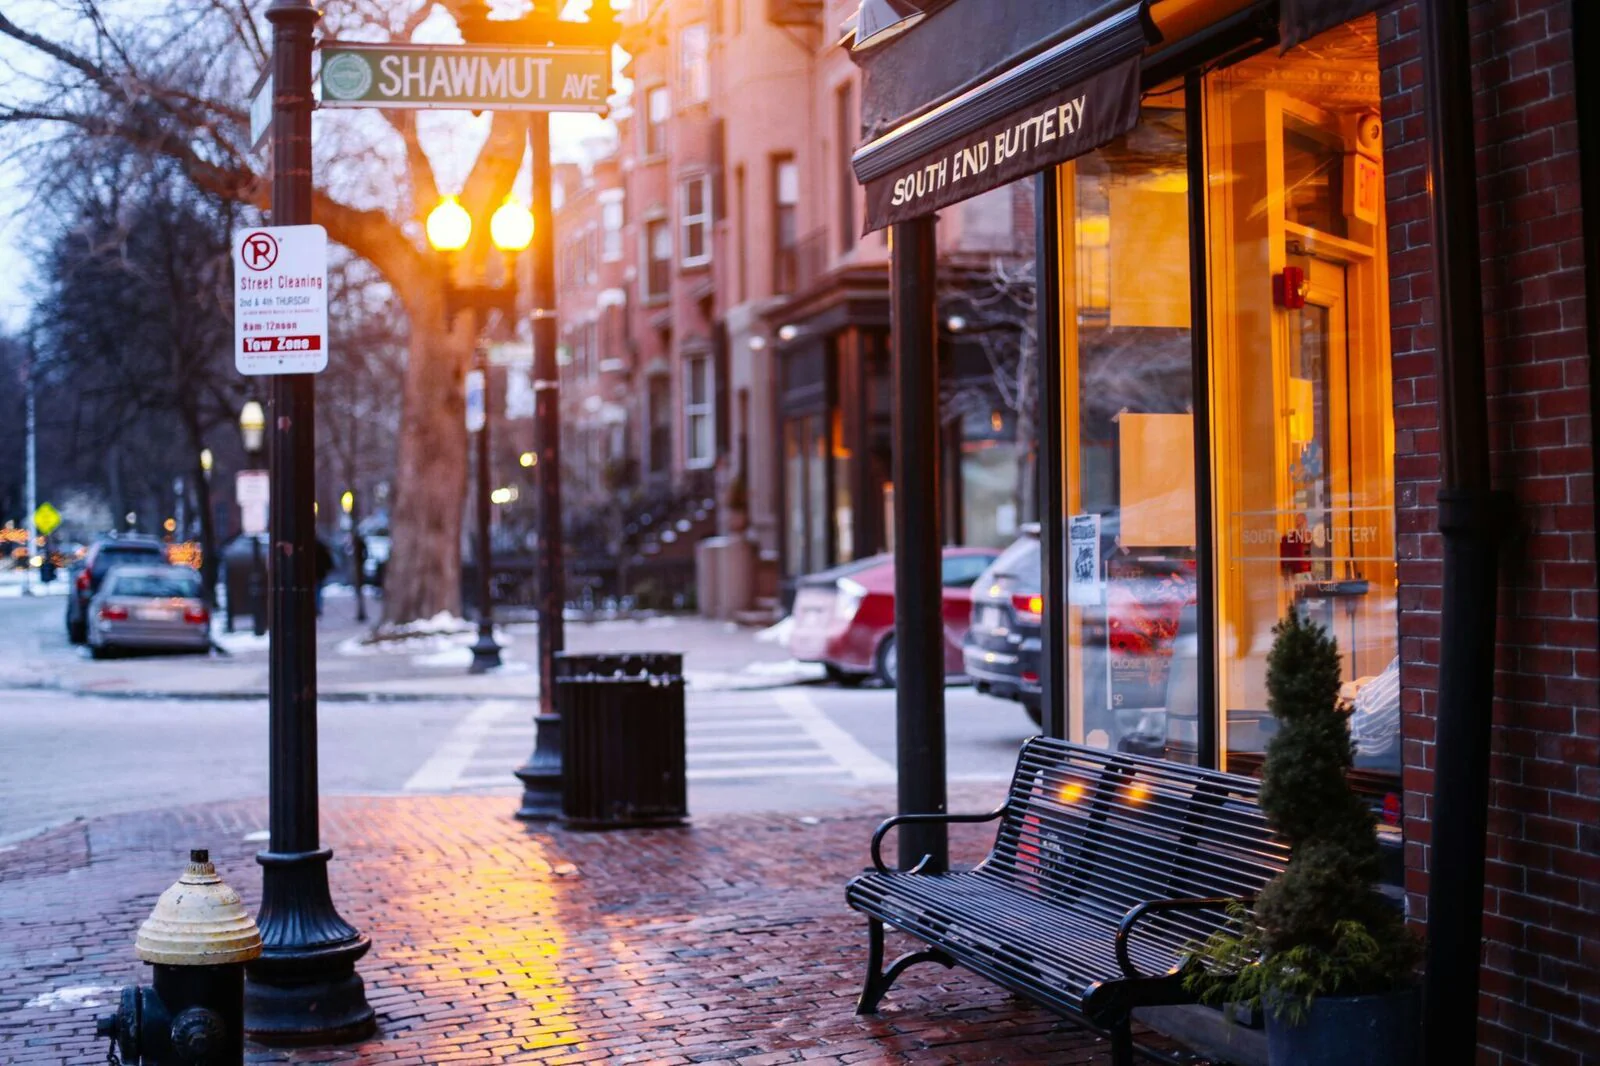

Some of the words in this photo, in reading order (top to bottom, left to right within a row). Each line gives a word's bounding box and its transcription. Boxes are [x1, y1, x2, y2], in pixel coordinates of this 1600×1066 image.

[378, 54, 553, 99] SHAWMUT
[561, 74, 601, 101] AVE
[891, 156, 948, 206] SOUTH
[952, 140, 989, 183] END
[994, 94, 1086, 166] BUTTERY
[241, 276, 273, 291] Street
[278, 274, 323, 289] Cleaning
[275, 295, 311, 306] THURSDAY
[245, 337, 272, 352] Tow
[277, 335, 310, 351] Zone
[1286, 528, 1313, 544] END
